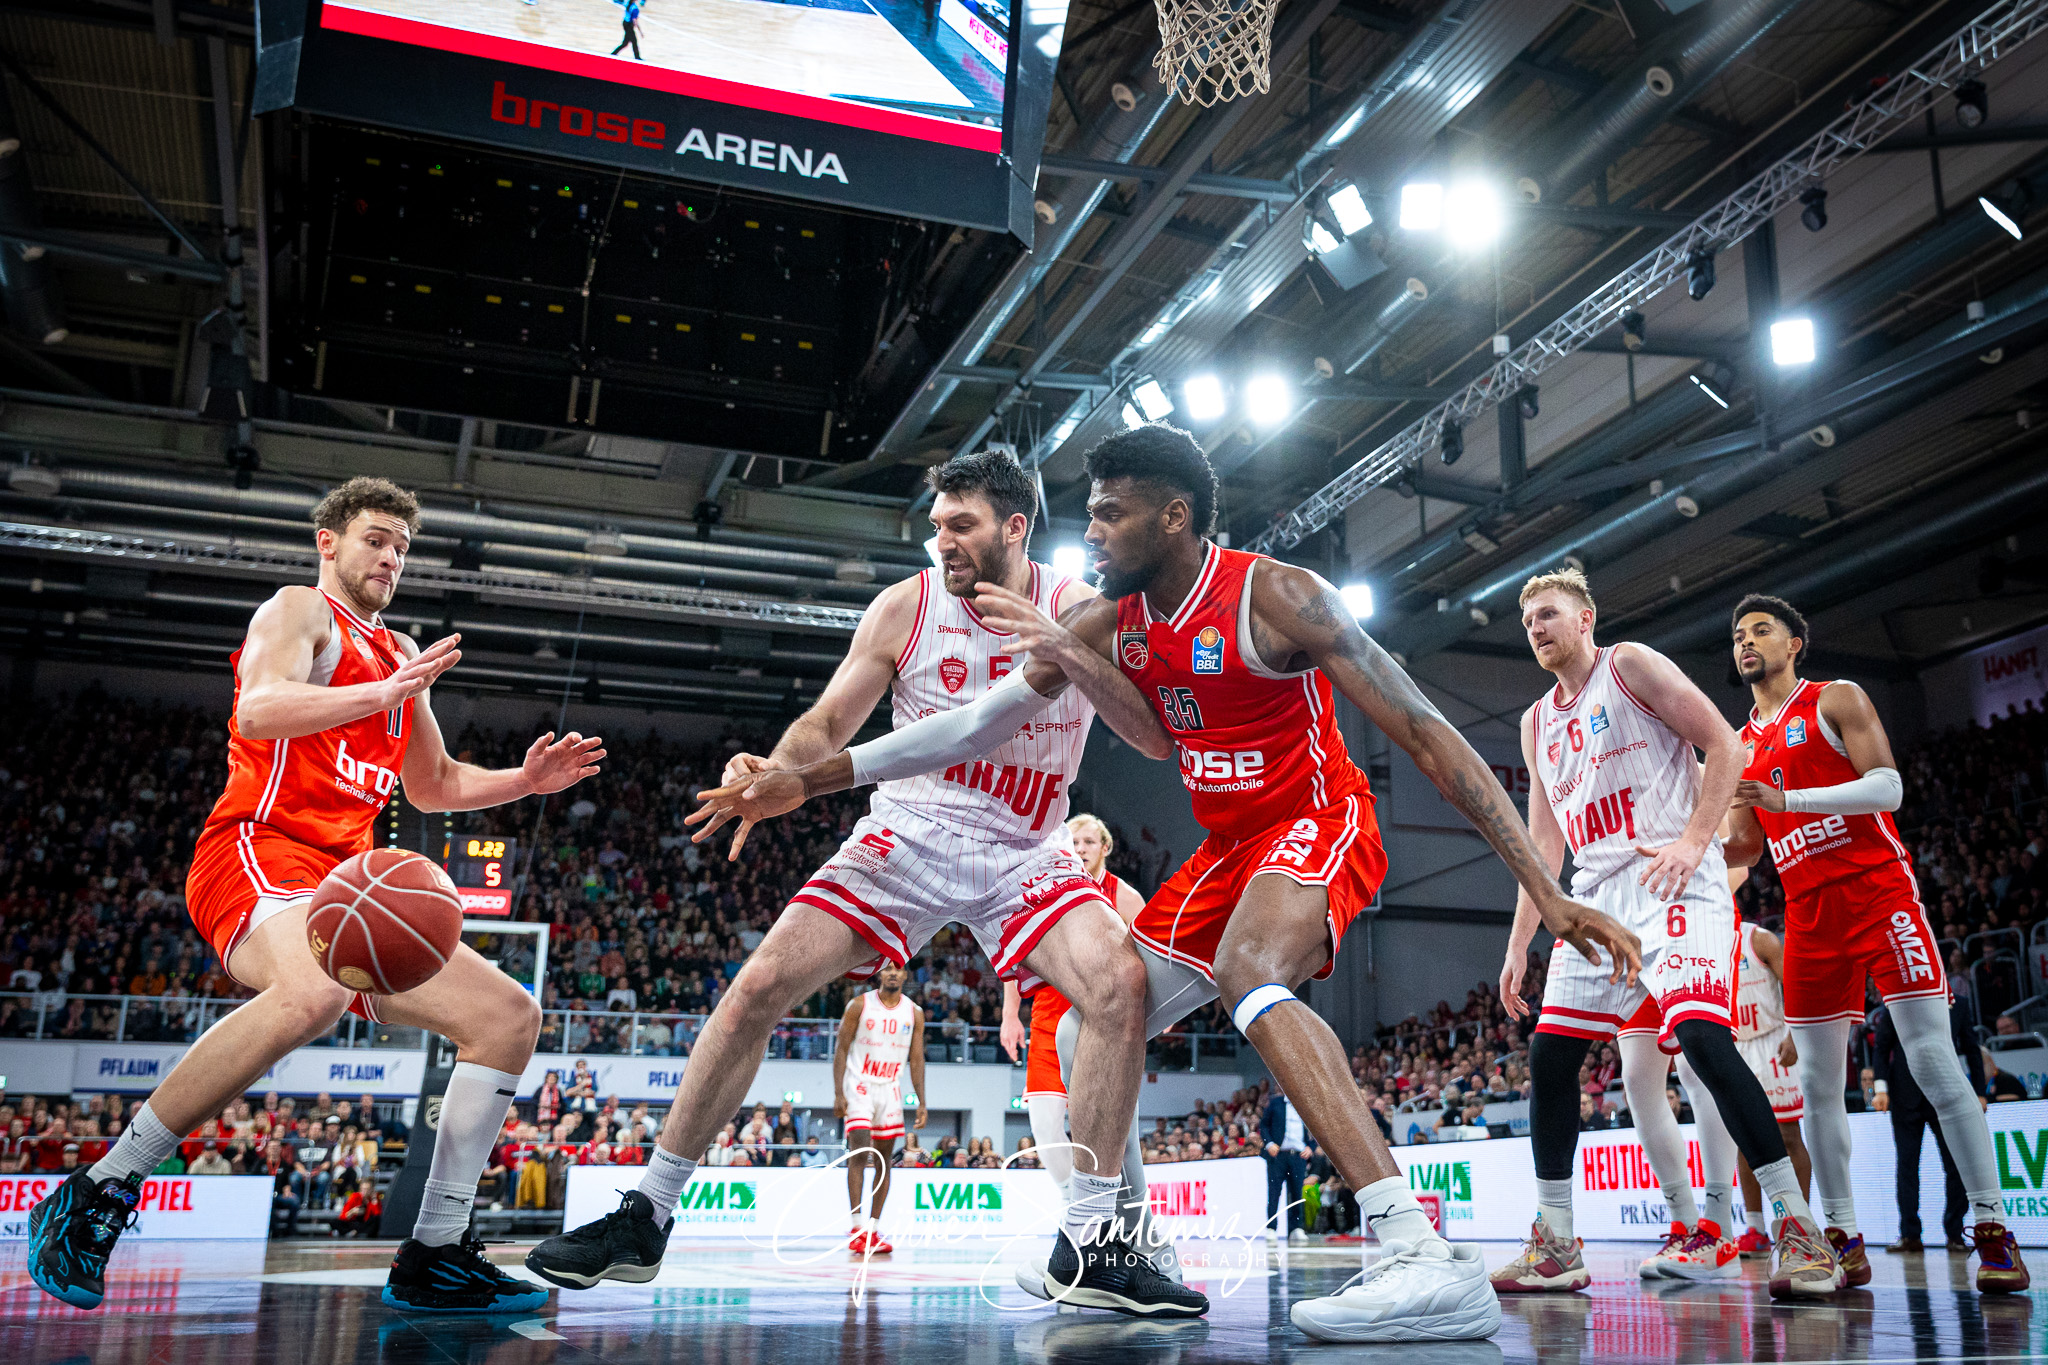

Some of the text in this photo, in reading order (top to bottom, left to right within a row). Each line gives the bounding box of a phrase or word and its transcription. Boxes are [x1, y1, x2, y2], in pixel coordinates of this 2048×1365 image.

[491, 81, 849, 184] brose ARENA
[938, 624, 971, 637] SPALDING
[989, 656, 1012, 681] 5
[1196, 660, 1218, 670] BBL
[1157, 685, 1205, 732] 35
[1567, 718, 1584, 753] 6
[1598, 740, 1648, 763] SPRINTIS
[1198, 779, 1264, 793] Automobile
[1767, 814, 1848, 864] brose
[1804, 836, 1852, 858] Automobile
[485, 861, 502, 887] 5
[1667, 904, 1686, 938] 6
[883, 1019, 897, 1034] 10
[100, 1057, 160, 1077] PFLAUM
[329, 1063, 384, 1081] PFLAUM
[862, 1053, 901, 1081] KNAUF
[916, 1183, 964, 1209] LVM
